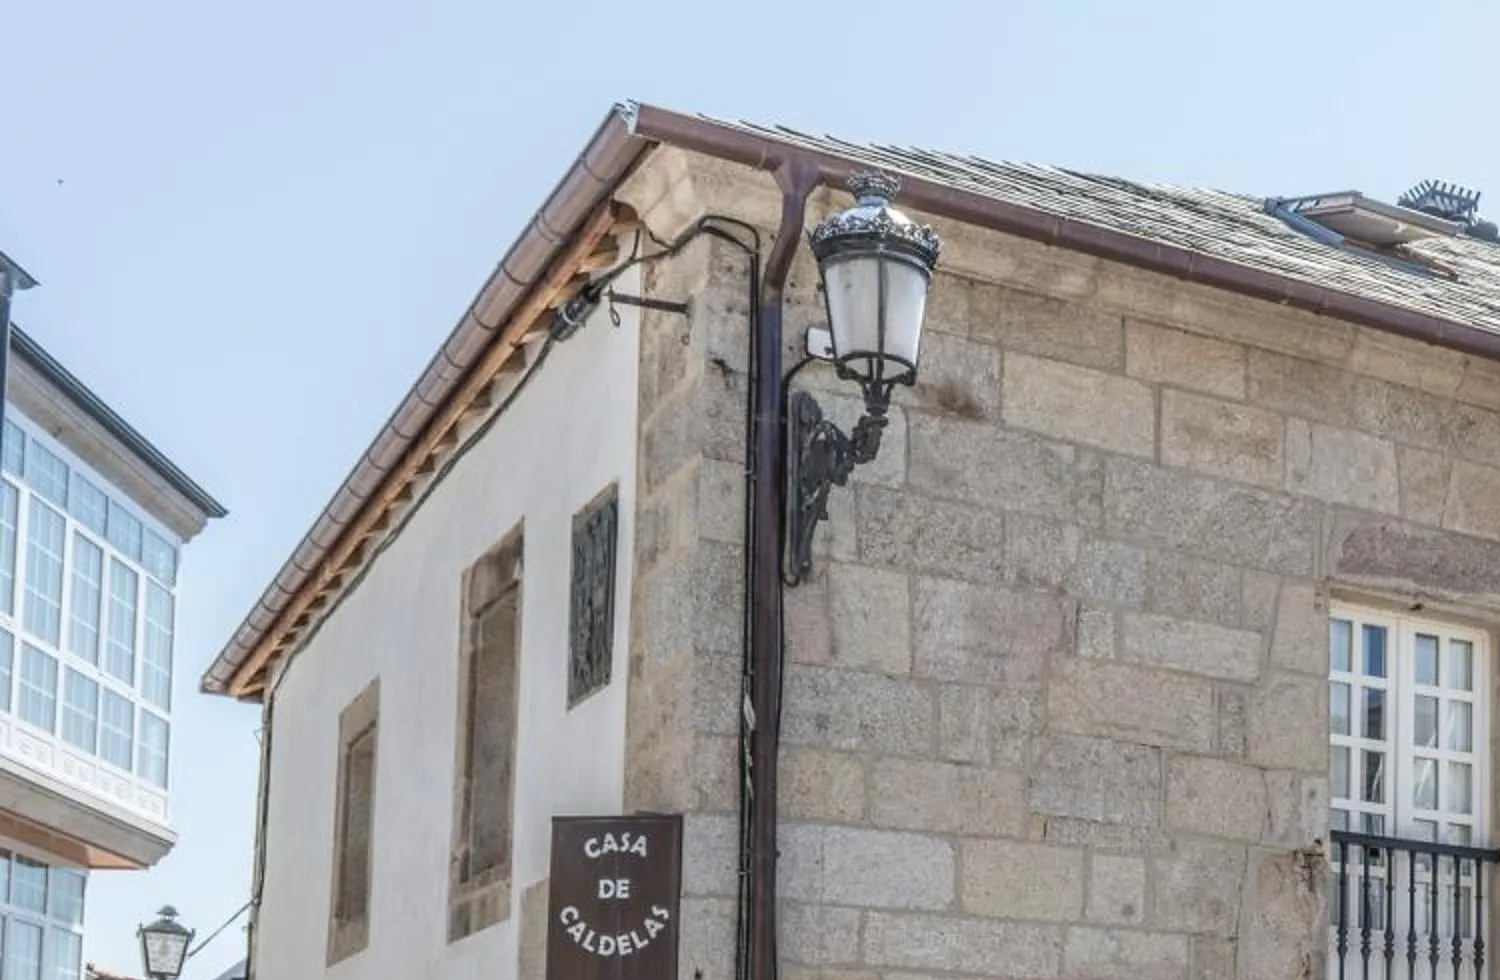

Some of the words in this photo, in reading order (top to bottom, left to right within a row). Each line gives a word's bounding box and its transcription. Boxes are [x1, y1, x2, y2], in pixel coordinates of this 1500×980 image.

[584, 832, 647, 858] CASA
[598, 879, 630, 899] DE
[560, 905, 669, 956] CALDELAS
